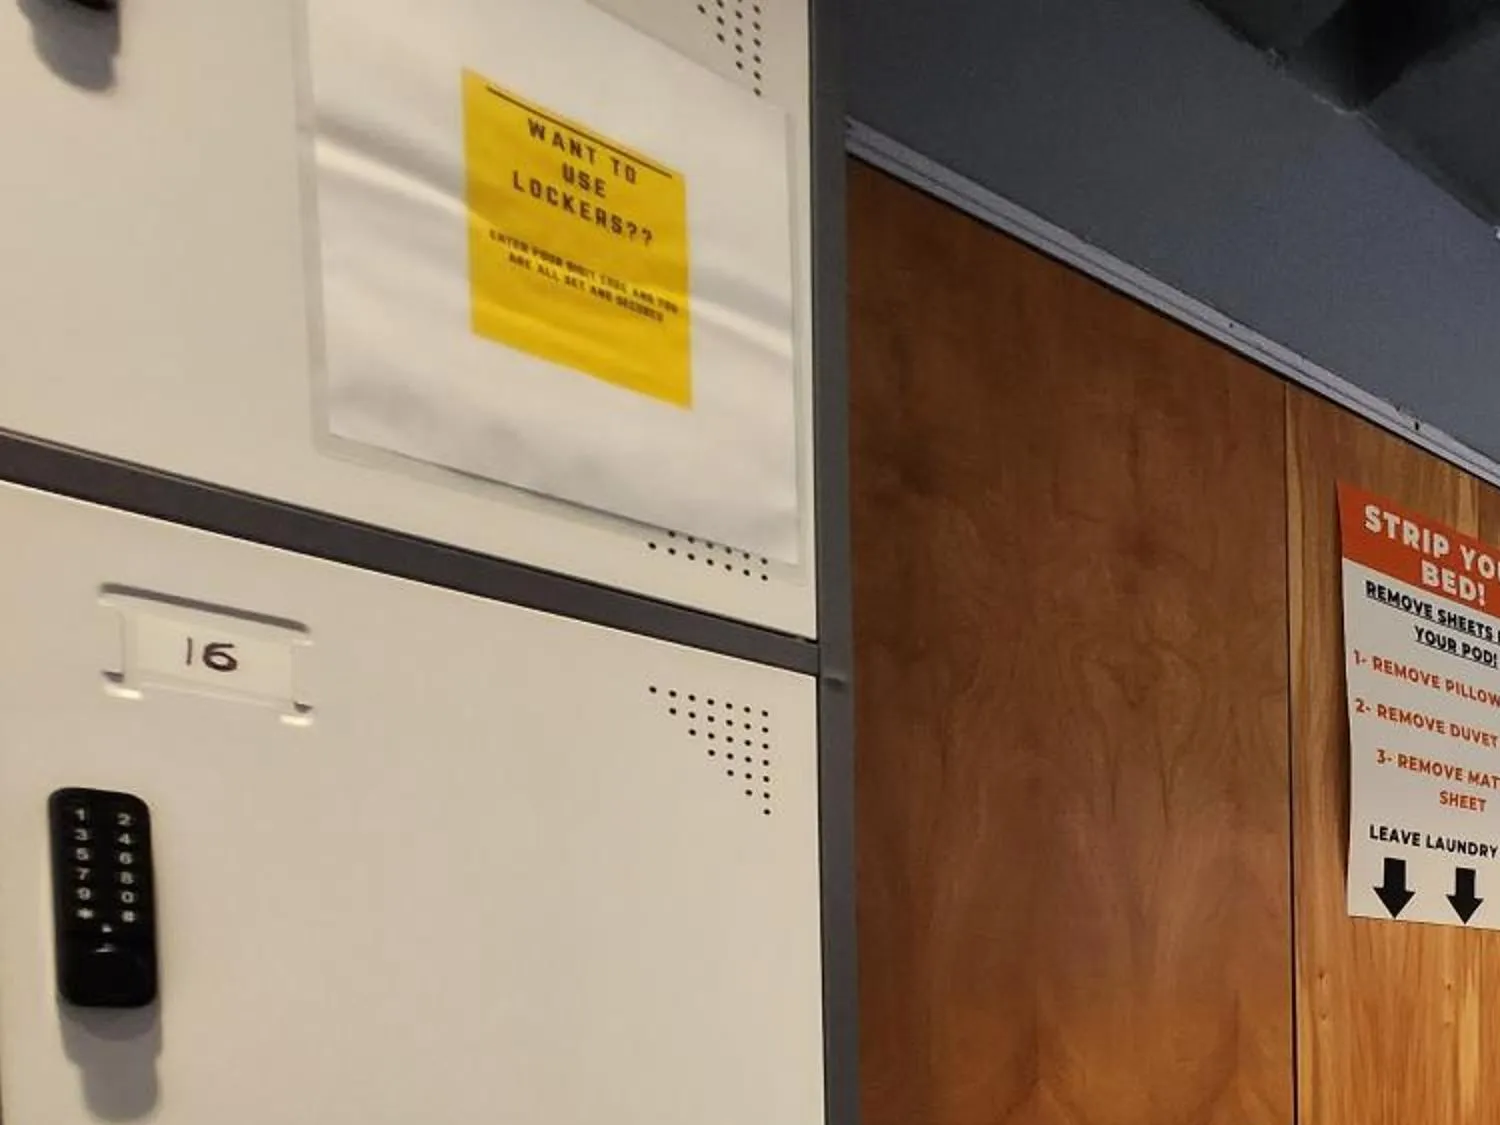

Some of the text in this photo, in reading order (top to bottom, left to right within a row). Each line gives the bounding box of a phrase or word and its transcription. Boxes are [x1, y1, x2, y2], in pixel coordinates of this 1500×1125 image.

[527, 117, 637, 185] WANT TO
[562, 161, 607, 199] USE
[512, 169, 653, 248] LOCKERS??
[537, 263, 560, 283] ALL
[1363, 503, 1450, 559] STRIP
[1420, 559, 1486, 607] BED!
[1364, 579, 1434, 620] REMOVE
[1437, 607, 1494, 642] SHEETS
[185, 636, 239, 674] 16
[1414, 624, 1457, 655] YOUR
[1353, 649, 1368, 665] 1-
[1372, 655, 1442, 690] REMOVE
[1355, 698, 1371, 715] 2-
[1377, 703, 1446, 735] REMOVE
[1449, 723, 1500, 748] DUVET
[1376, 748, 1393, 765] 3-
[1397, 753, 1463, 781] REMOVE
[74, 807, 132, 827] 1 2
[1439, 790, 1487, 813] SHEET
[1369, 823, 1421, 847] LEAVE
[1425, 834, 1499, 859] LAUNDRY
[121, 890, 135, 904] 0
